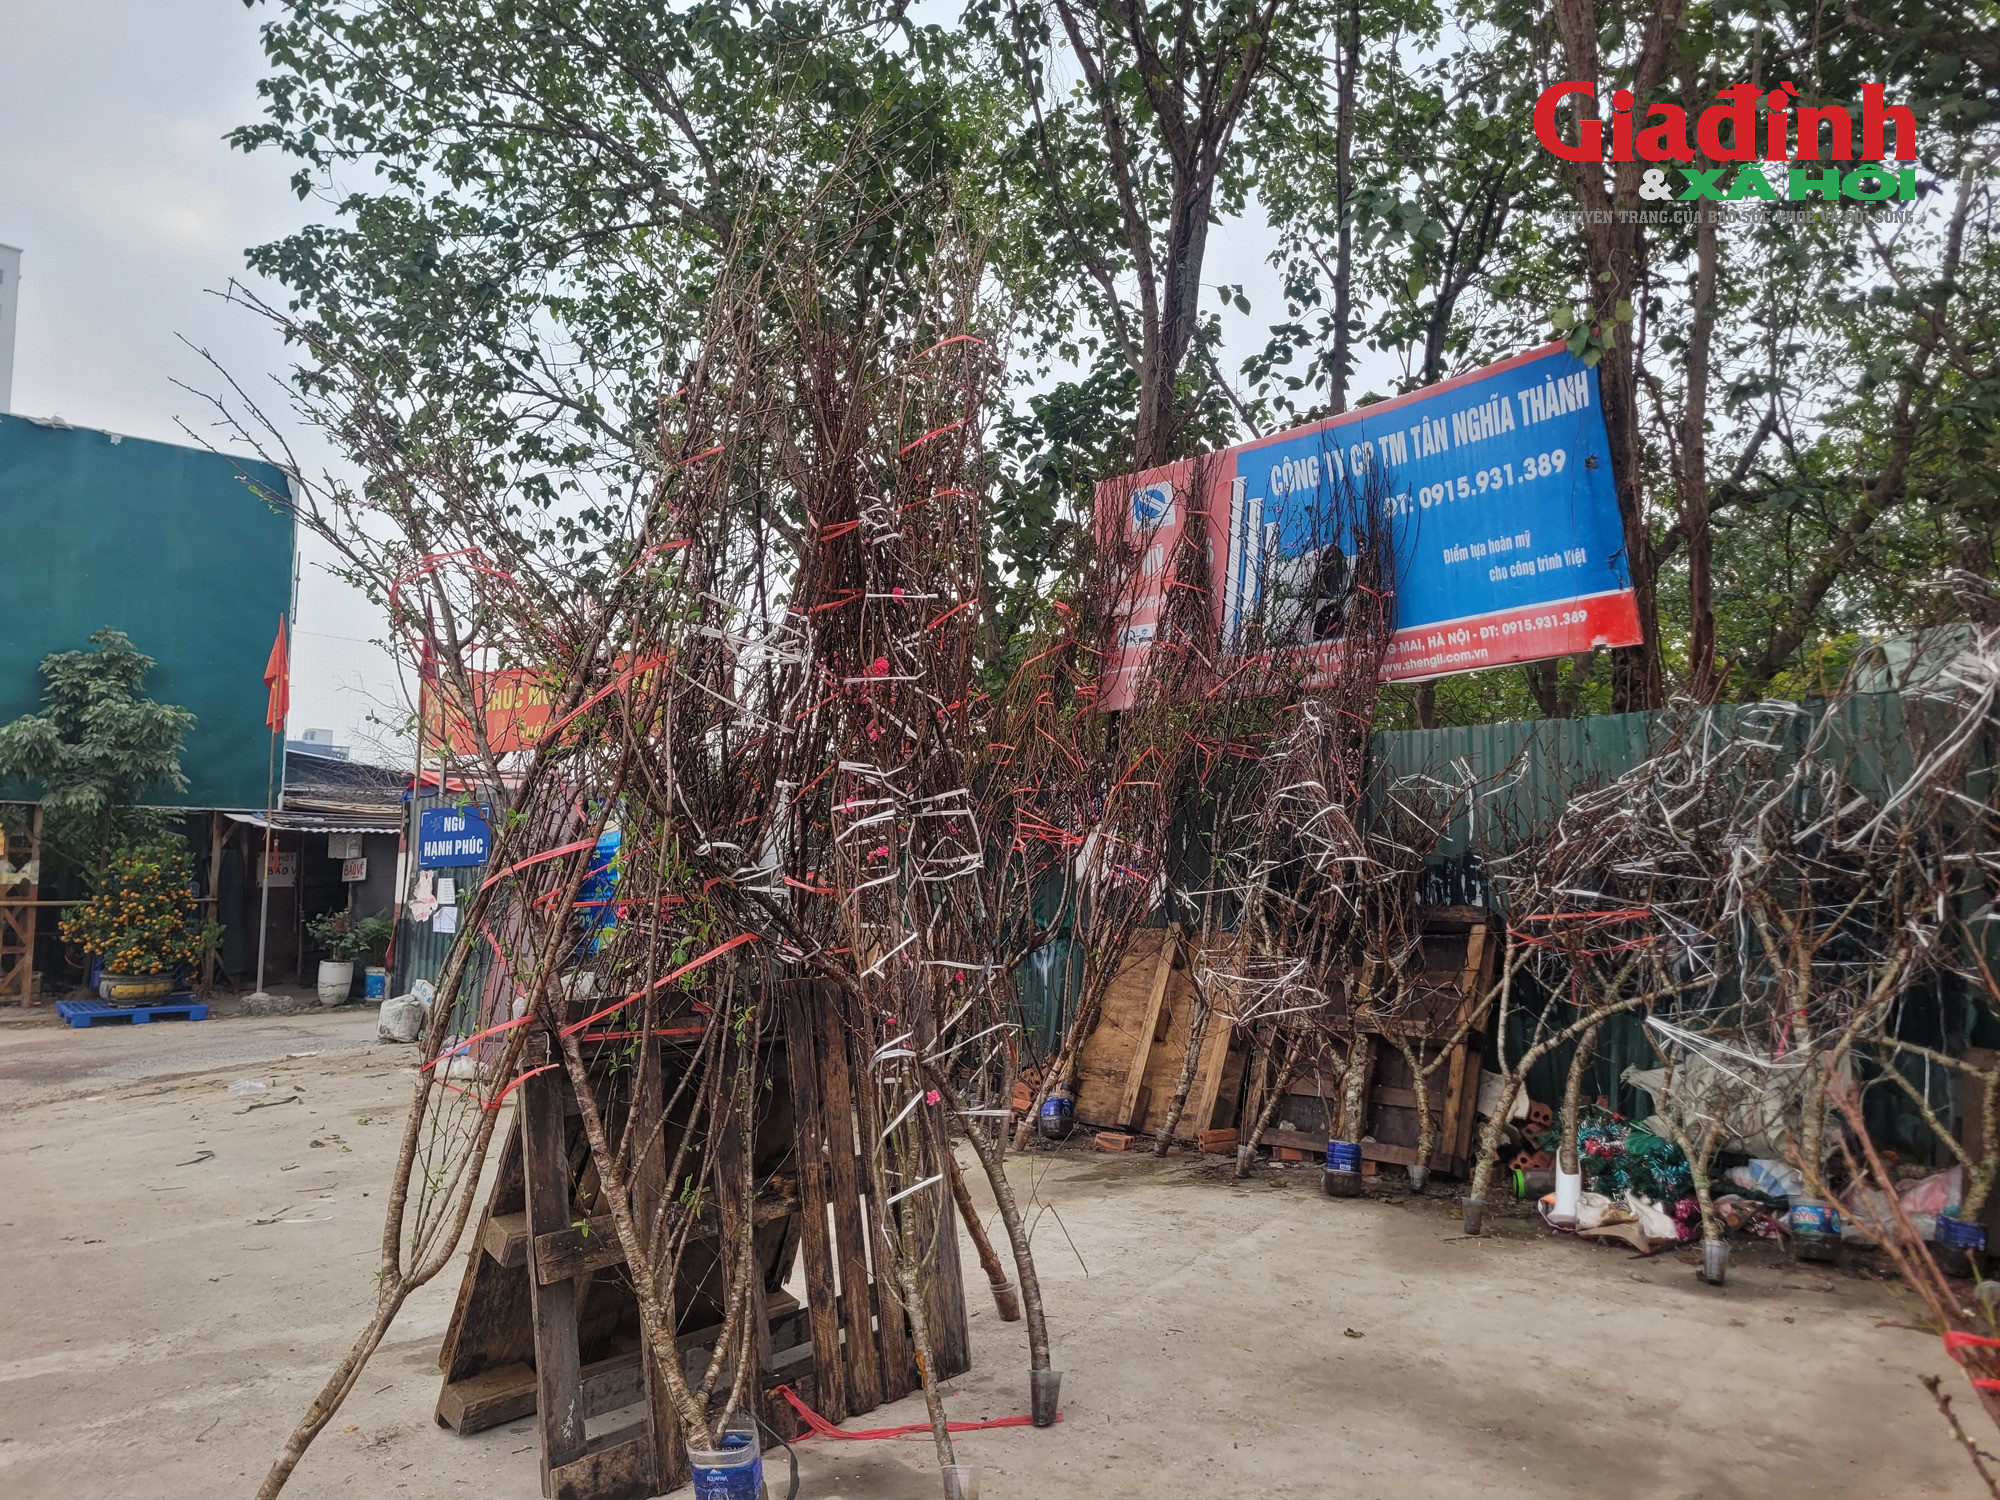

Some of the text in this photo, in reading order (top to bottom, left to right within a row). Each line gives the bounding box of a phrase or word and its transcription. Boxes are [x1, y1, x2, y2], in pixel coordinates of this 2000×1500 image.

[1270, 455, 1320, 497] CÔNG
[1323, 448, 1345, 483] TY
[1378, 430, 1408, 468] TM
[1410, 415, 1449, 459] TÂN
[1452, 392, 1515, 447] NGHĨA
[1518, 370, 1590, 426] THÀNH
[1419, 448, 1566, 509] 0915.931.389
[1443, 530, 1531, 564] Điểm tựa hoàn mỹ
[1489, 547, 1587, 582] cho công trình Việt
[1427, 632, 1446, 648] HÀ
[1447, 628, 1471, 645] NỘI
[1479, 626, 1500, 640] ĐT:
[423, 835, 484, 859] HẠNH PHÚC
